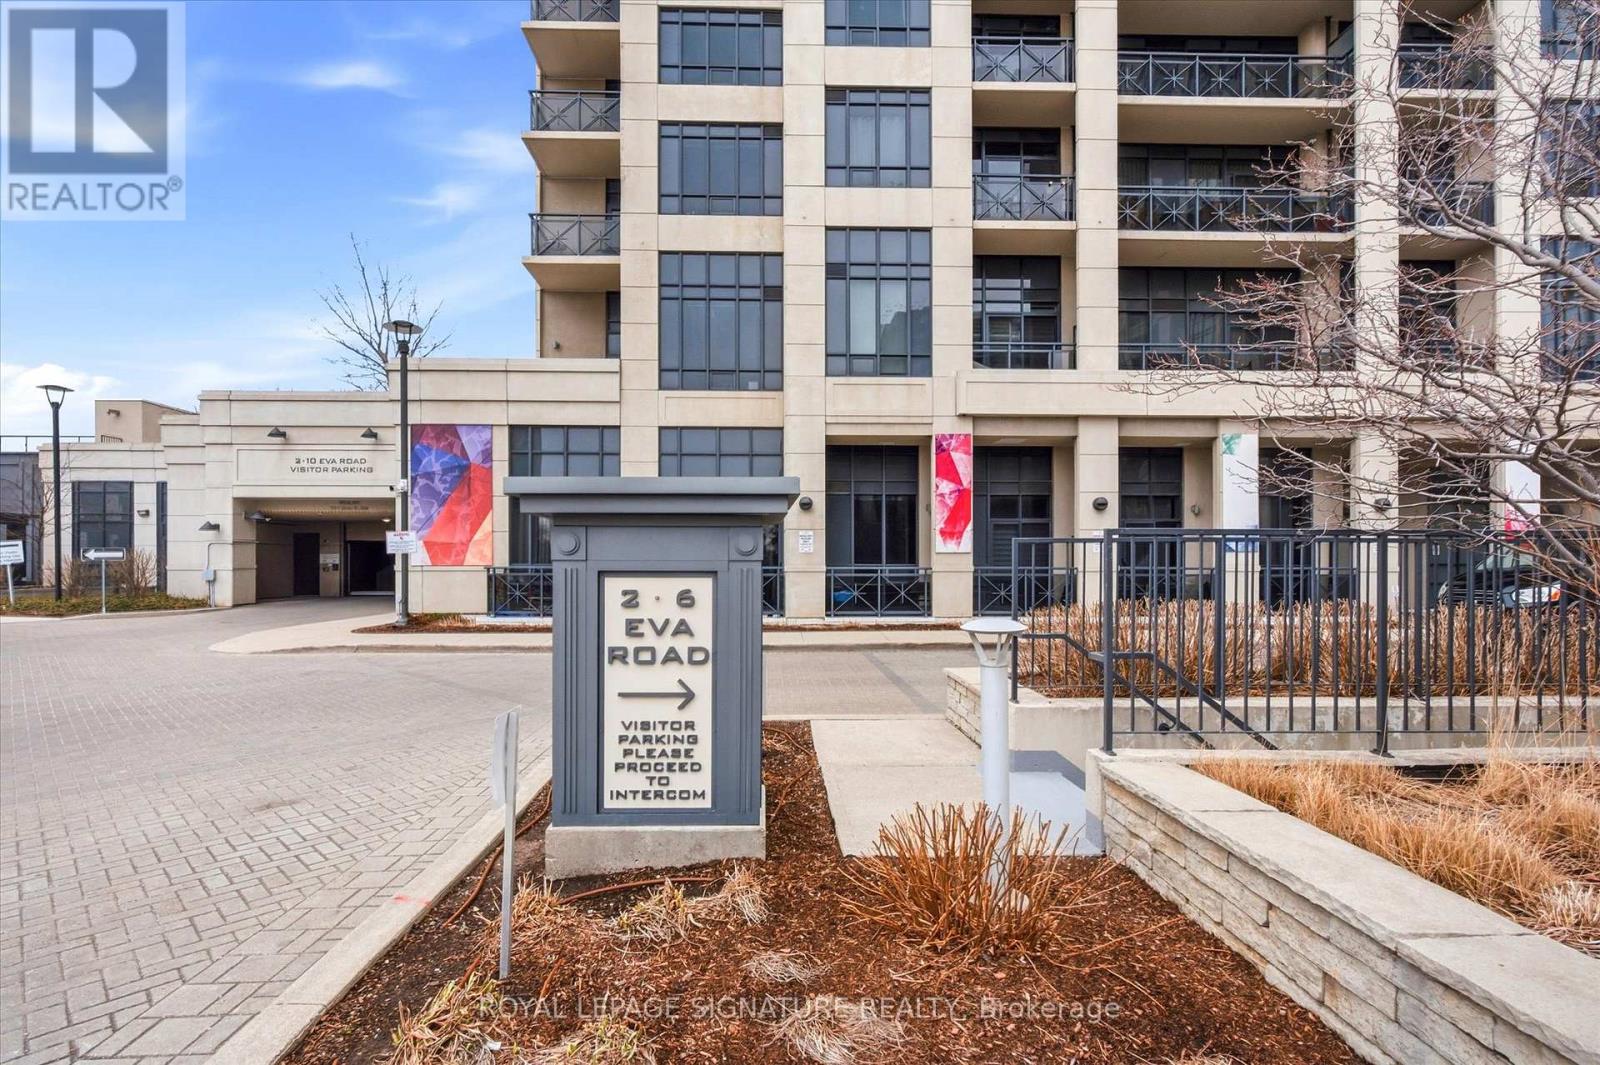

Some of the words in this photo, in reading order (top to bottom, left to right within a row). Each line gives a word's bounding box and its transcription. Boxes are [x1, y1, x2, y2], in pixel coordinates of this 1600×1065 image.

[319, 457, 337, 465] EVA
[339, 457, 367, 465] ROAD
[624, 618, 695, 638] EVA
[607, 646, 710, 665] ROAD
[621, 720, 696, 731] VISITOR
[618, 734, 698, 745] PARKING
[622, 748, 694, 759] PLEASE
[614, 762, 702, 773] PROCEED
[645, 775, 670, 787] TO
[609, 789, 706, 801] INTERCOM
